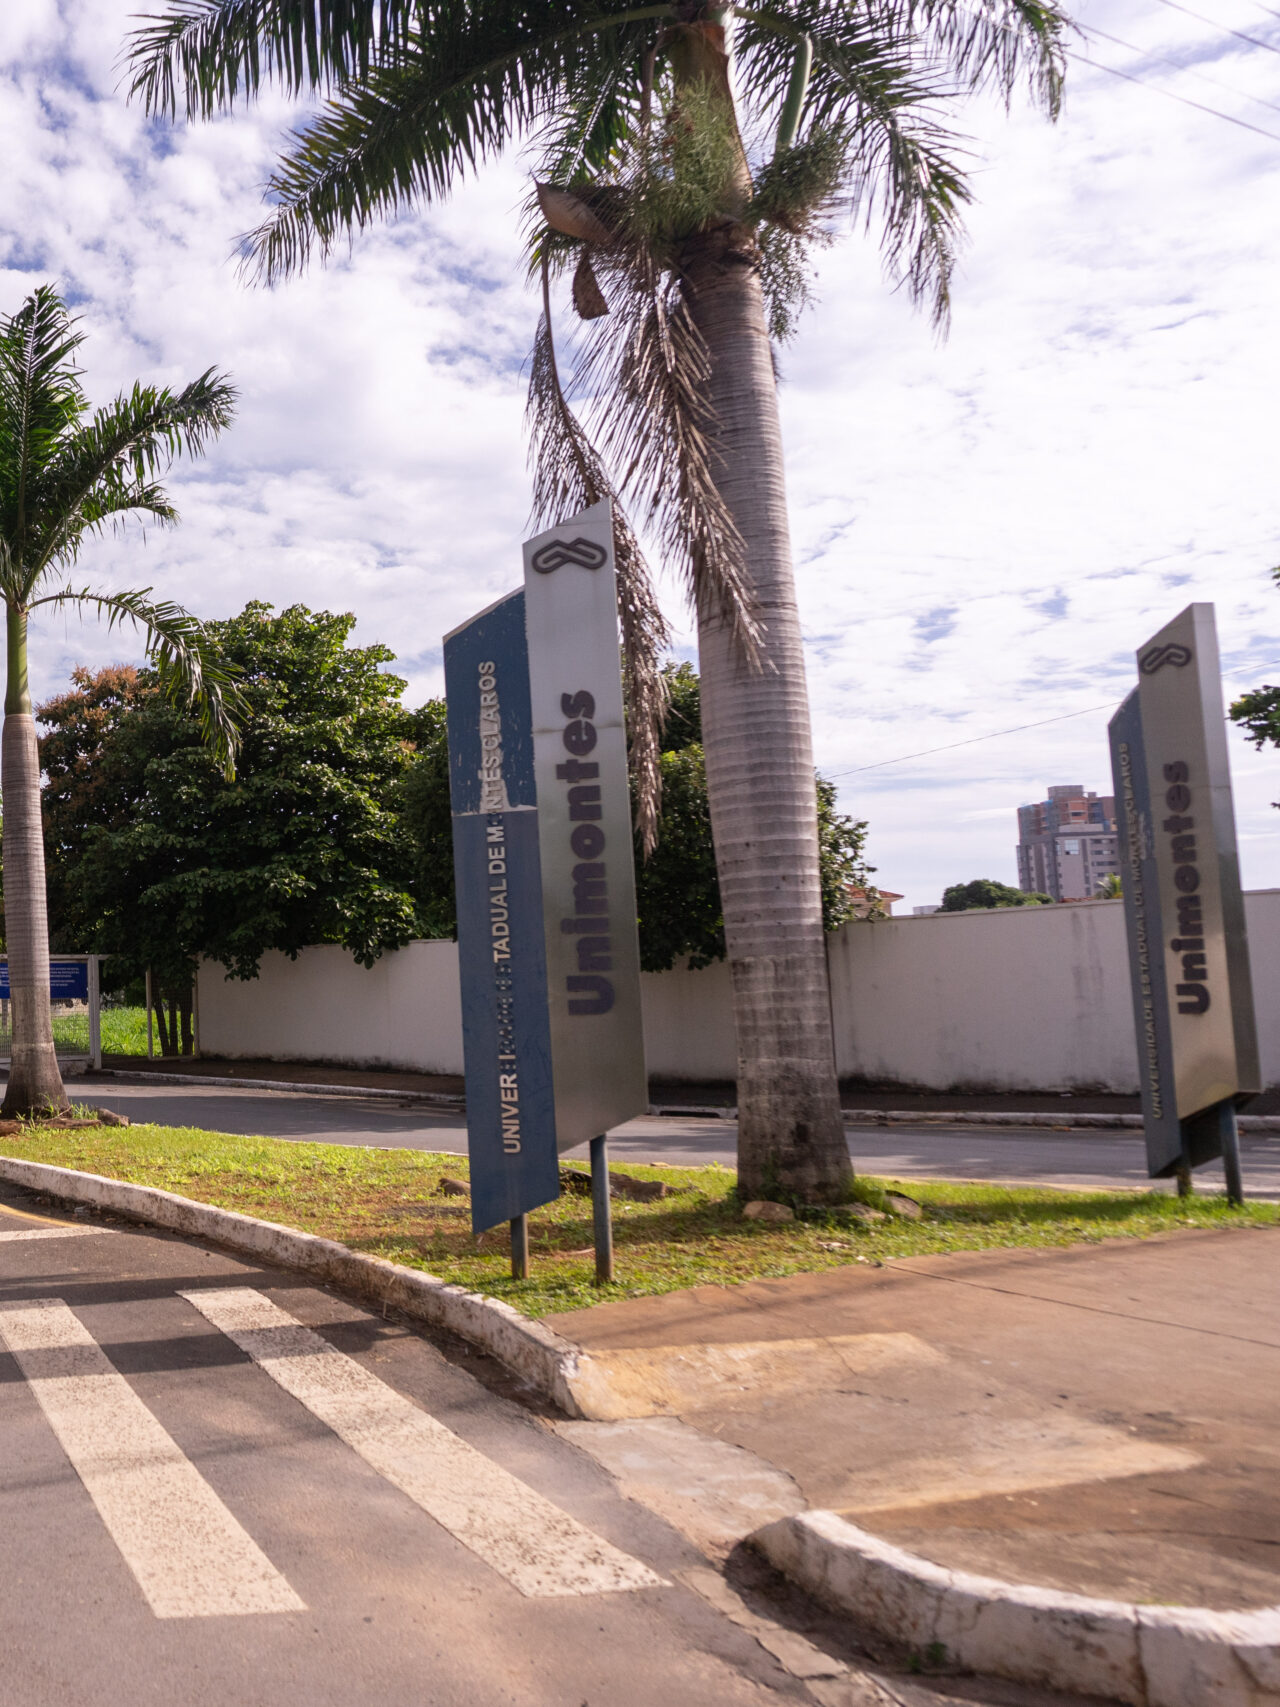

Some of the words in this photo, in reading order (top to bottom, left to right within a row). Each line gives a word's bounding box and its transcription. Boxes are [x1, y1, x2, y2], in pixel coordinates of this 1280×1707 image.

[478, 660, 501, 750] CLAROS
[481, 754, 505, 842] MNTES
[487, 846, 506, 875] DE
[556, 690, 616, 1016] Unimontes
[1133, 887, 1145, 905] DE
[1162, 761, 1211, 1015] Unimontes
[1135, 912, 1152, 995] ESTADUAL
[1144, 1000, 1162, 1119] UNIVERSIDADE
